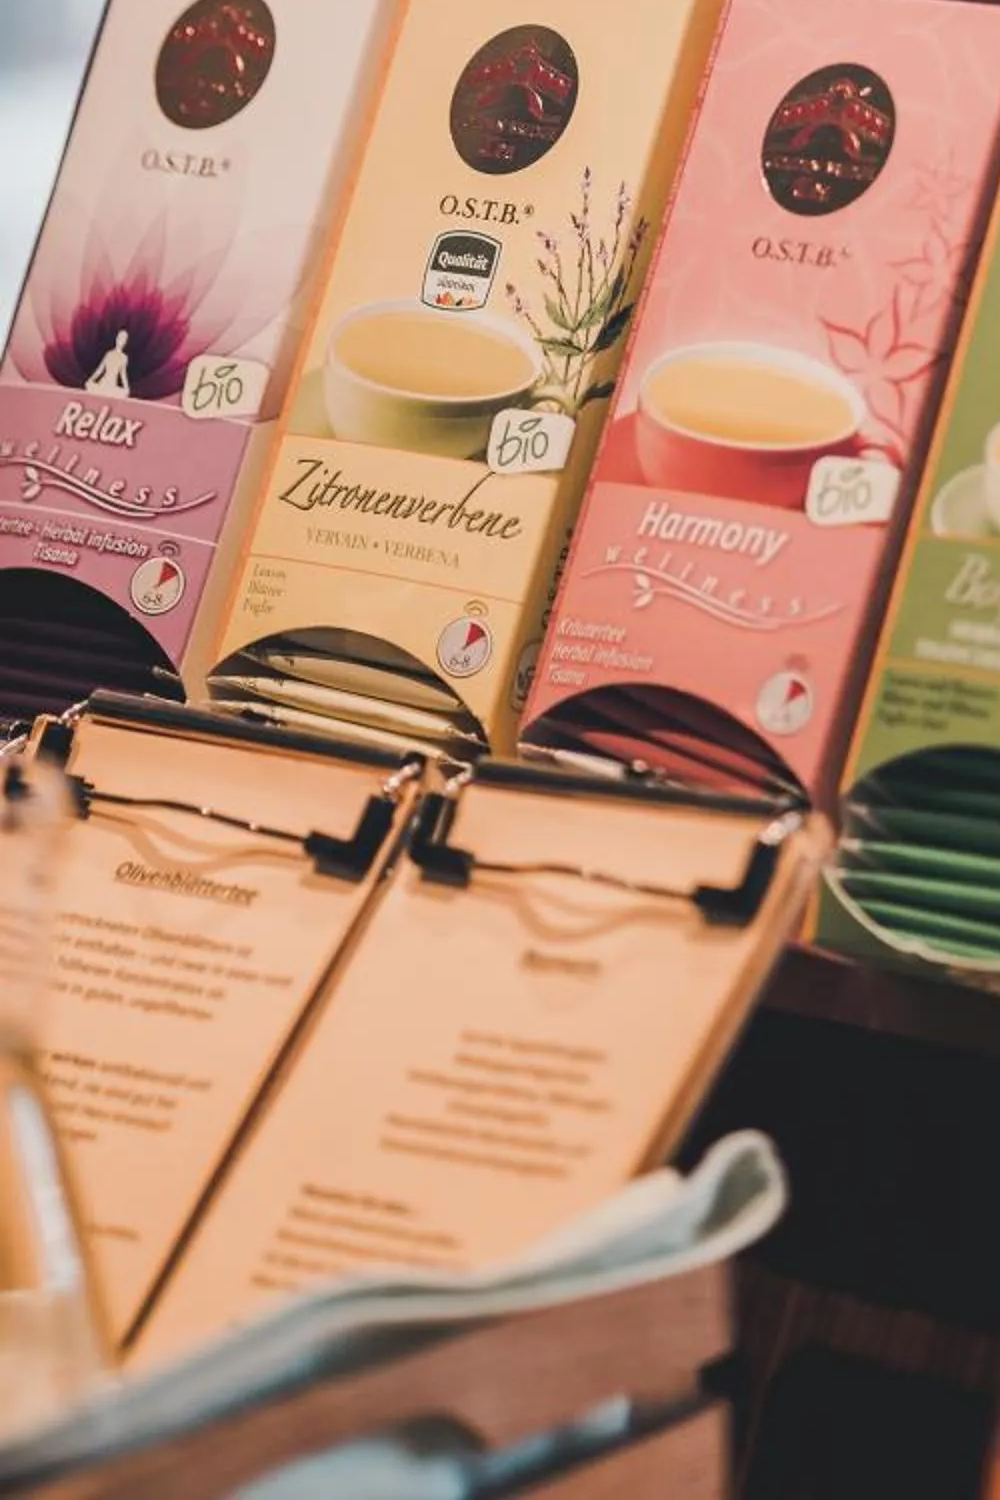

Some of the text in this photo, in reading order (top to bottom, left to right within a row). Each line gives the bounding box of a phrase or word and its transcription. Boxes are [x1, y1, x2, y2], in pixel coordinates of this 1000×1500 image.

[438, 251, 489, 271] Qualität
[192, 366, 244, 411] bio
[56, 401, 143, 446] Relax
[497, 418, 549, 468] bio
[279, 457, 525, 540] Zitronenverbene
[816, 467, 874, 518] bio
[306, 526, 462, 569] VERVAIN VERBENA
[637, 502, 790, 565] Harmony
